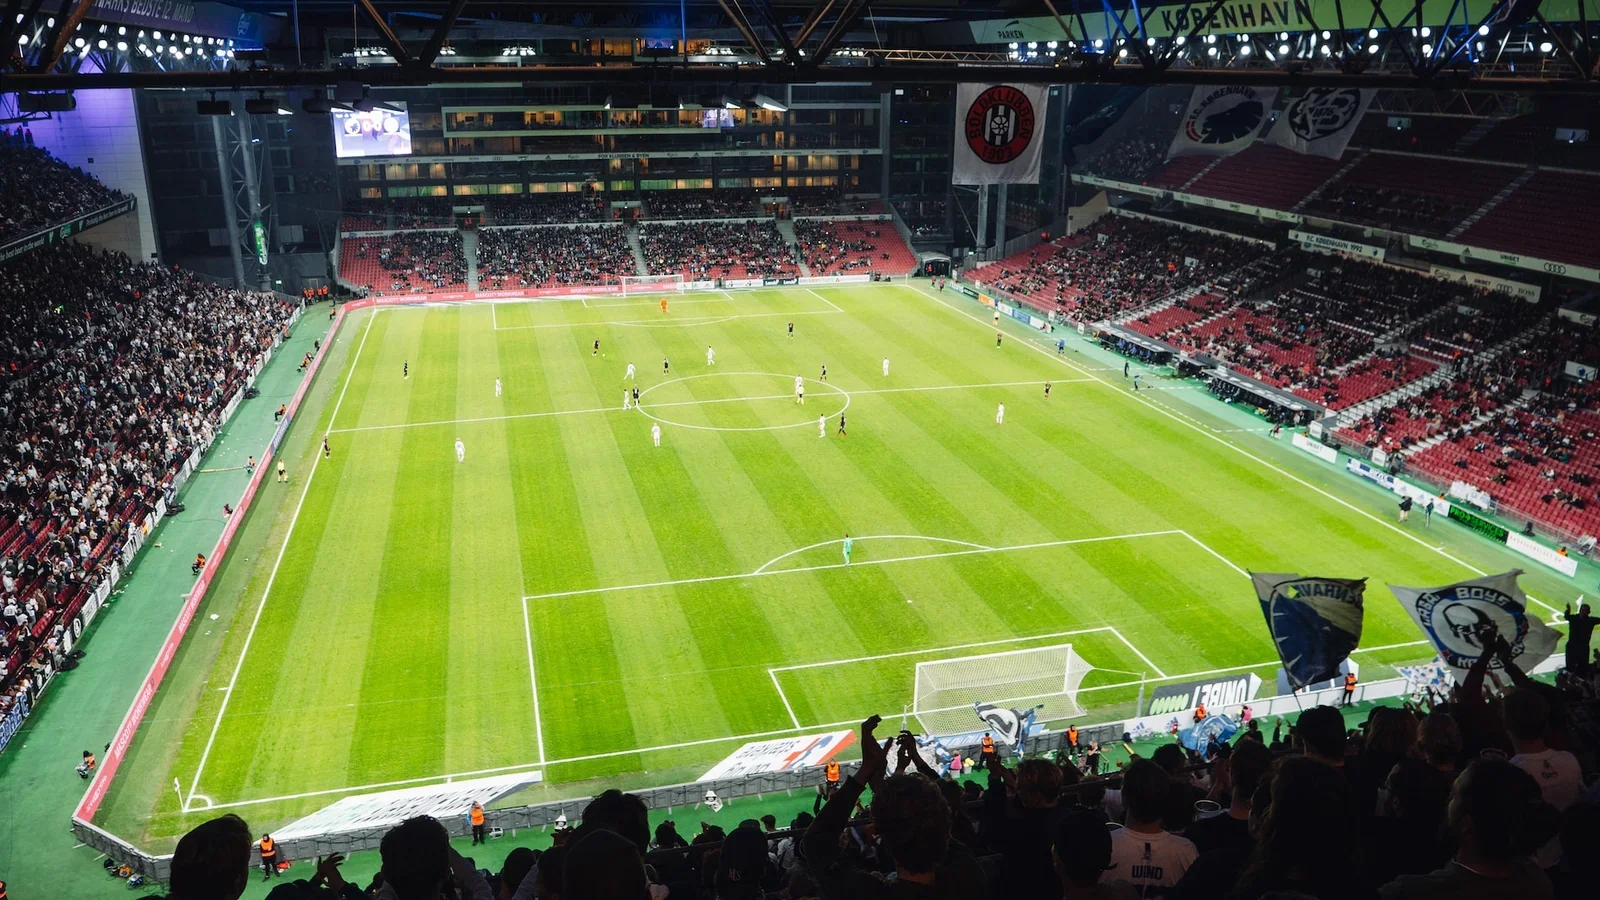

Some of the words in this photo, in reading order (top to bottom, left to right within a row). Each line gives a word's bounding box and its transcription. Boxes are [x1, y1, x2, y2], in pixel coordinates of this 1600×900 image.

[172, 5, 195, 23] MAND
[998, 30, 1024, 39] PARKEN
[968, 90, 1032, 139] BOLDKLUBBEN
[983, 145, 1013, 160] 1903
[1316, 237, 1348, 249] KØBENHAVN
[1500, 254, 1520, 262] UNIBET
[1474, 278, 1491, 286] UNIBET
[1455, 586, 1512, 607] BOYS
[1132, 865, 1163, 880] WIND
